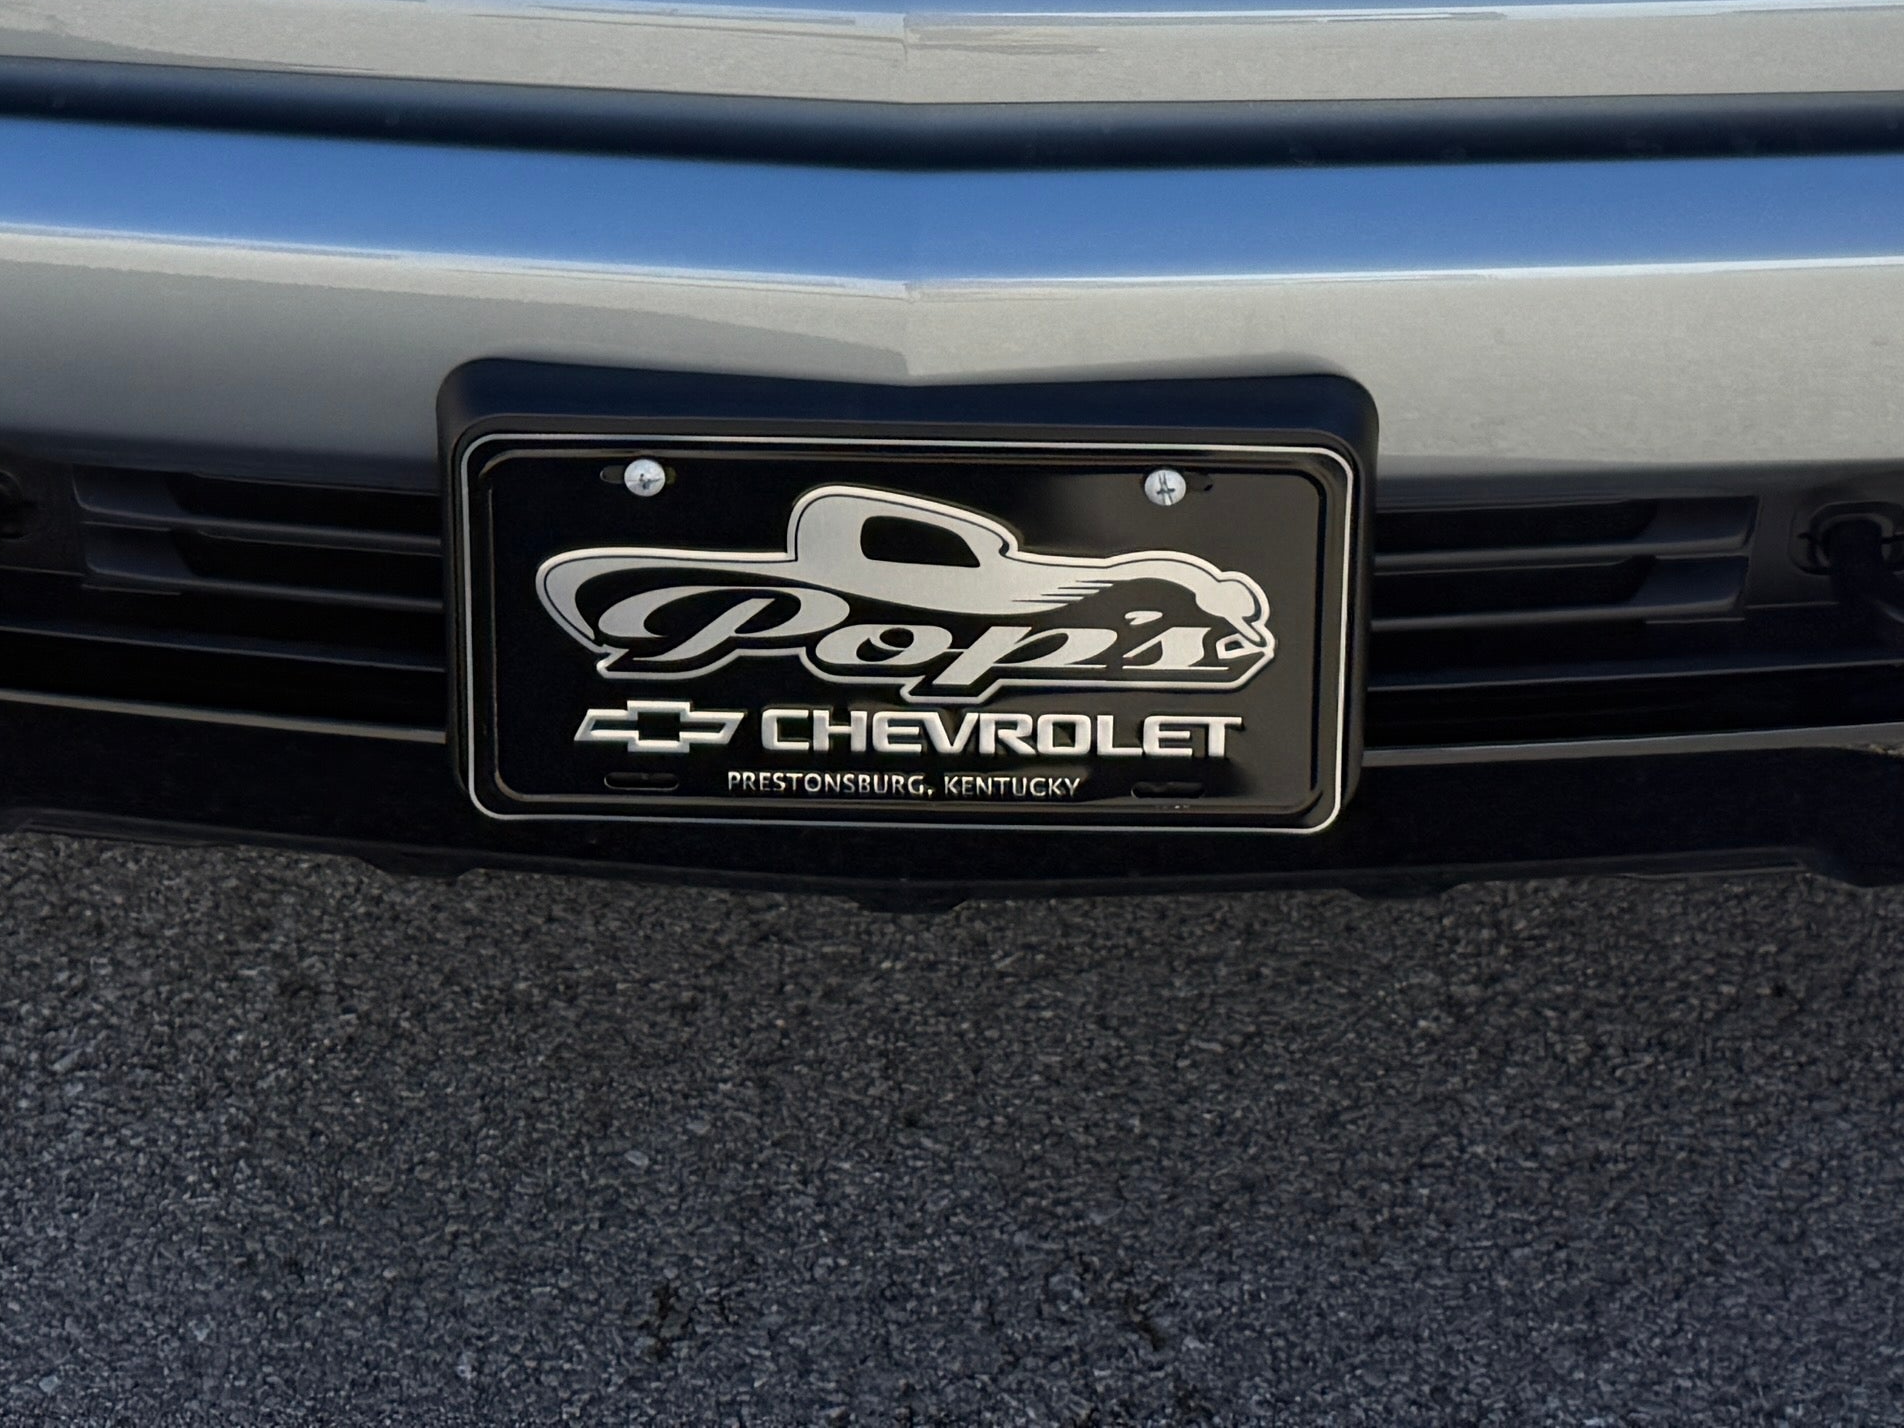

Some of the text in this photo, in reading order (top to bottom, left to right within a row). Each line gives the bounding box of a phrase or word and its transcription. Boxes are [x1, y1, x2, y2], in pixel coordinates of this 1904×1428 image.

[599, 586, 1230, 686] Pop's
[760, 708, 1244, 759] CHEVROLET
[727, 770, 1082, 800] PRESTONSBURG, KENTUCKY
